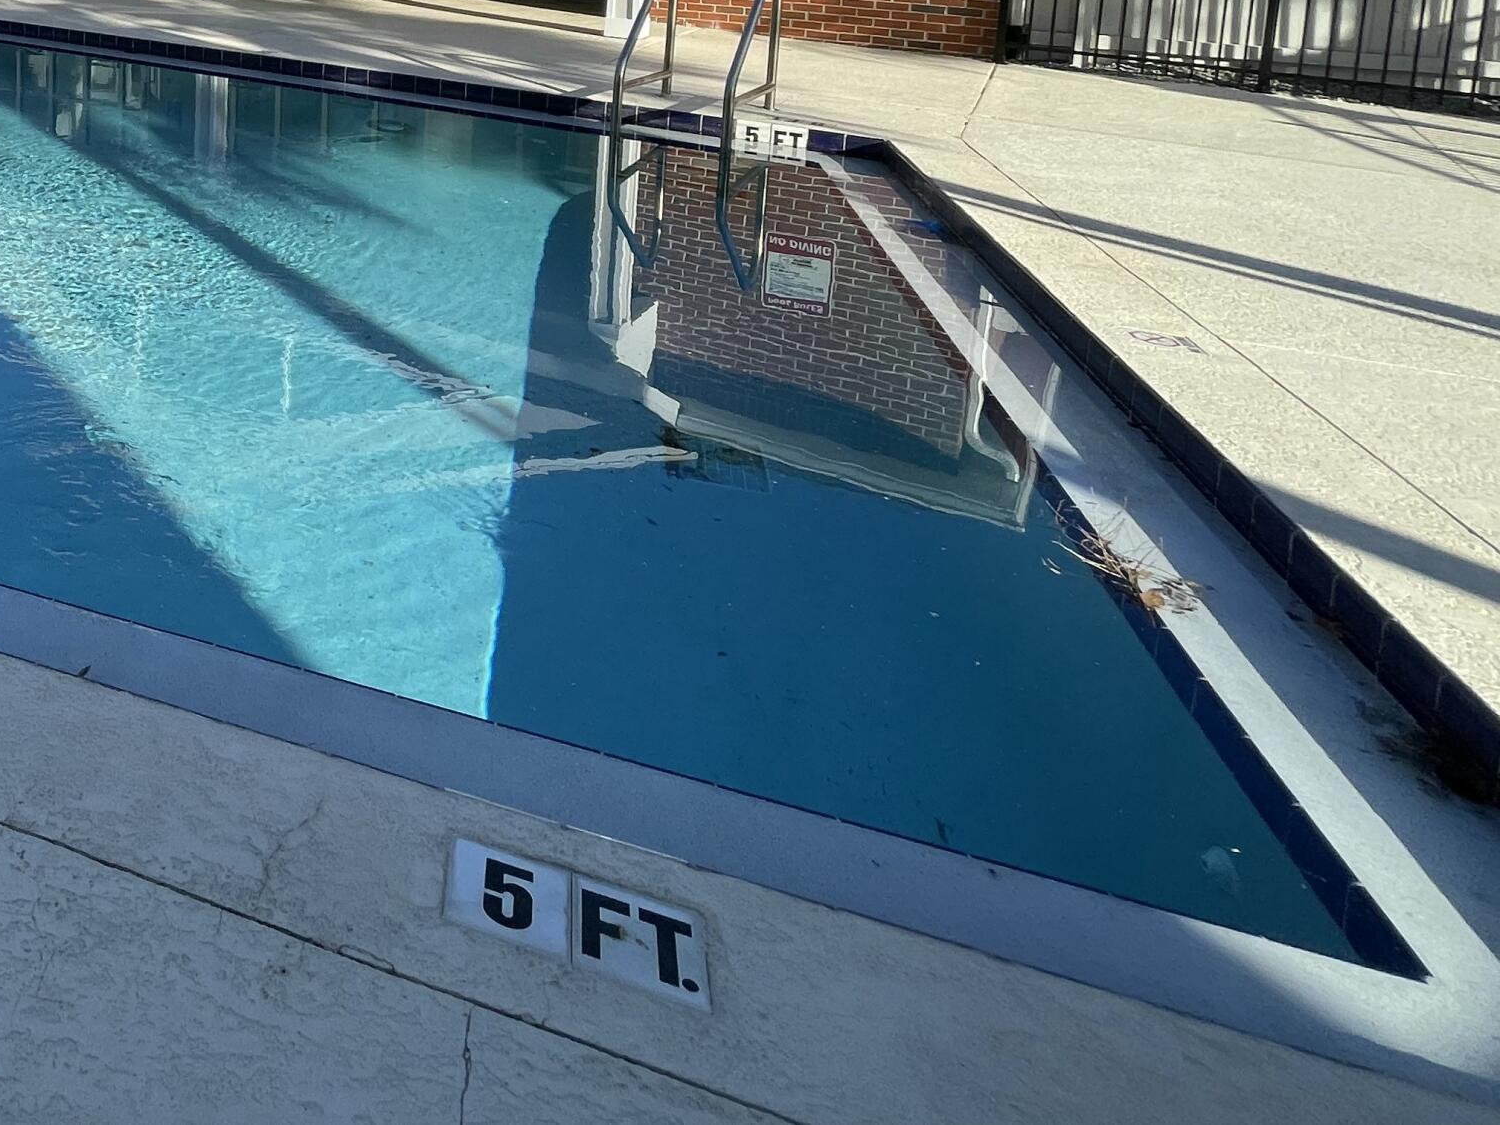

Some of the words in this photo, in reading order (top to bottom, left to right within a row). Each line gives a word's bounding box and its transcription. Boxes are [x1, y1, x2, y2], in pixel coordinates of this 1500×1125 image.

[773, 131, 803, 148] FT
[482, 857, 534, 930] 5
[580, 887, 700, 993] FT.
